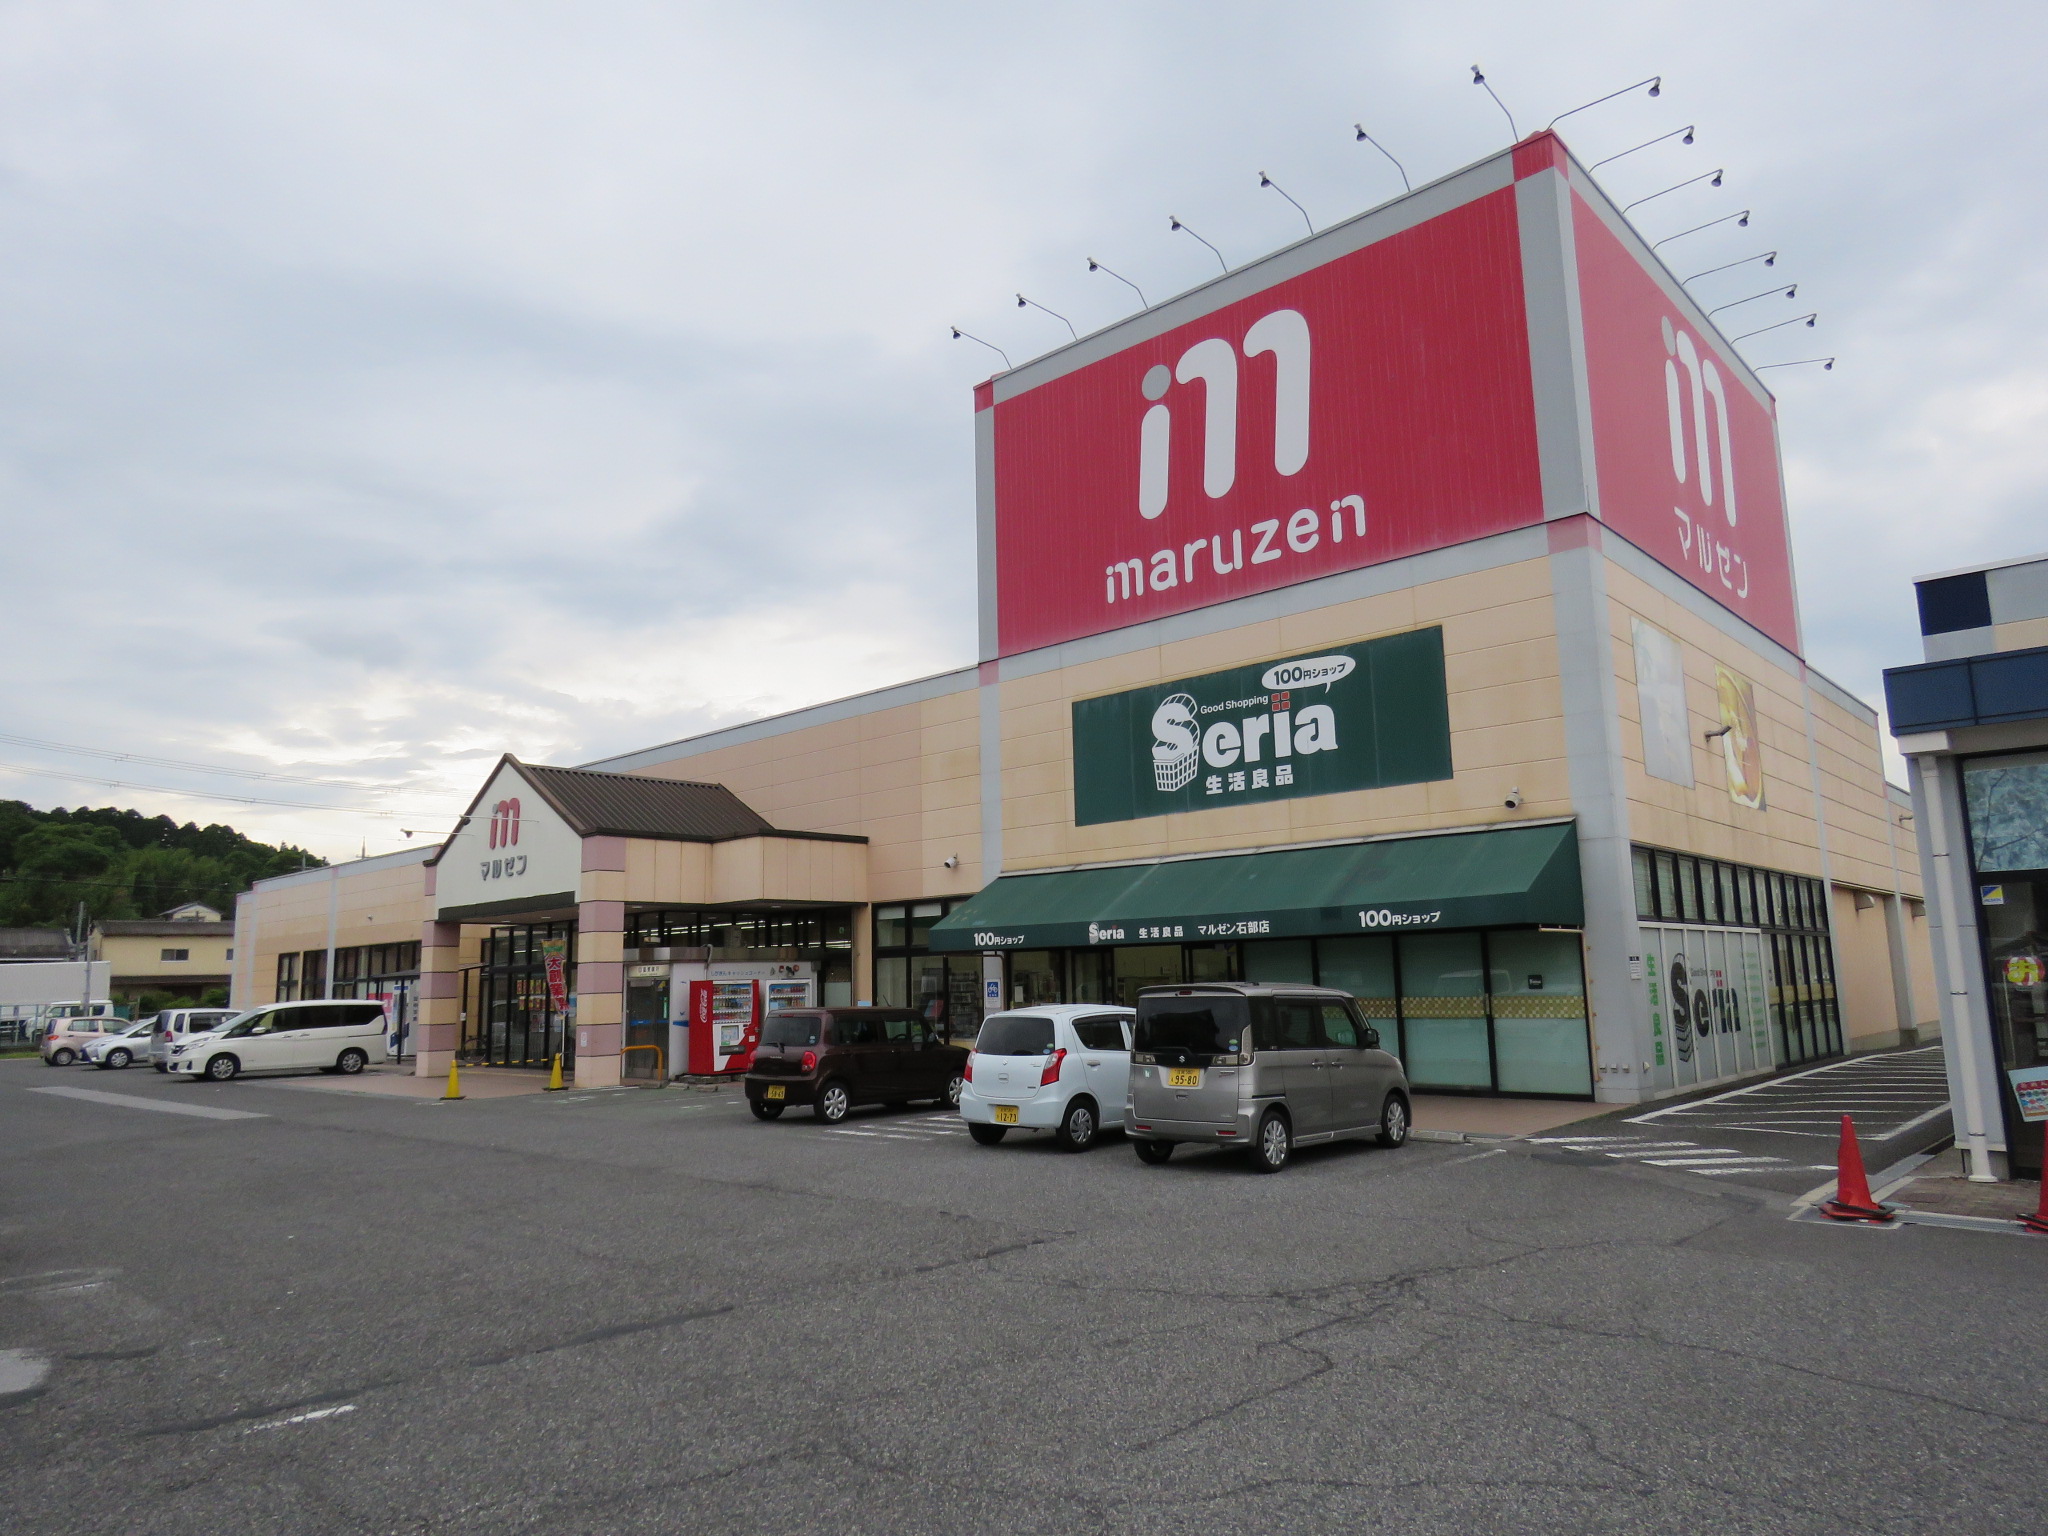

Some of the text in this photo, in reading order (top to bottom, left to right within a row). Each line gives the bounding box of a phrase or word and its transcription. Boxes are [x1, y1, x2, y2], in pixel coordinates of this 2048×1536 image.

[1105, 494, 1367, 604] maruzen
[1673, 506, 1748, 599] マルゼン
[1273, 662, 1347, 686] 100円ショップ
[1200, 694, 1269, 715] Good Shopping
[1151, 692, 1339, 770] Seria
[1205, 763, 1294, 796] 生活良品
[479, 854, 528, 881] マルゼン
[1197, 919, 1270, 936] マルゼン石部店
[1358, 909, 1441, 928] 100円ショップ
[973, 931, 1025, 947] 100円ショップ
[1088, 922, 1125, 943] Seria
[1138, 925, 1184, 940] 生活良品
[1174, 1075, 1198, 1085] 95-80
